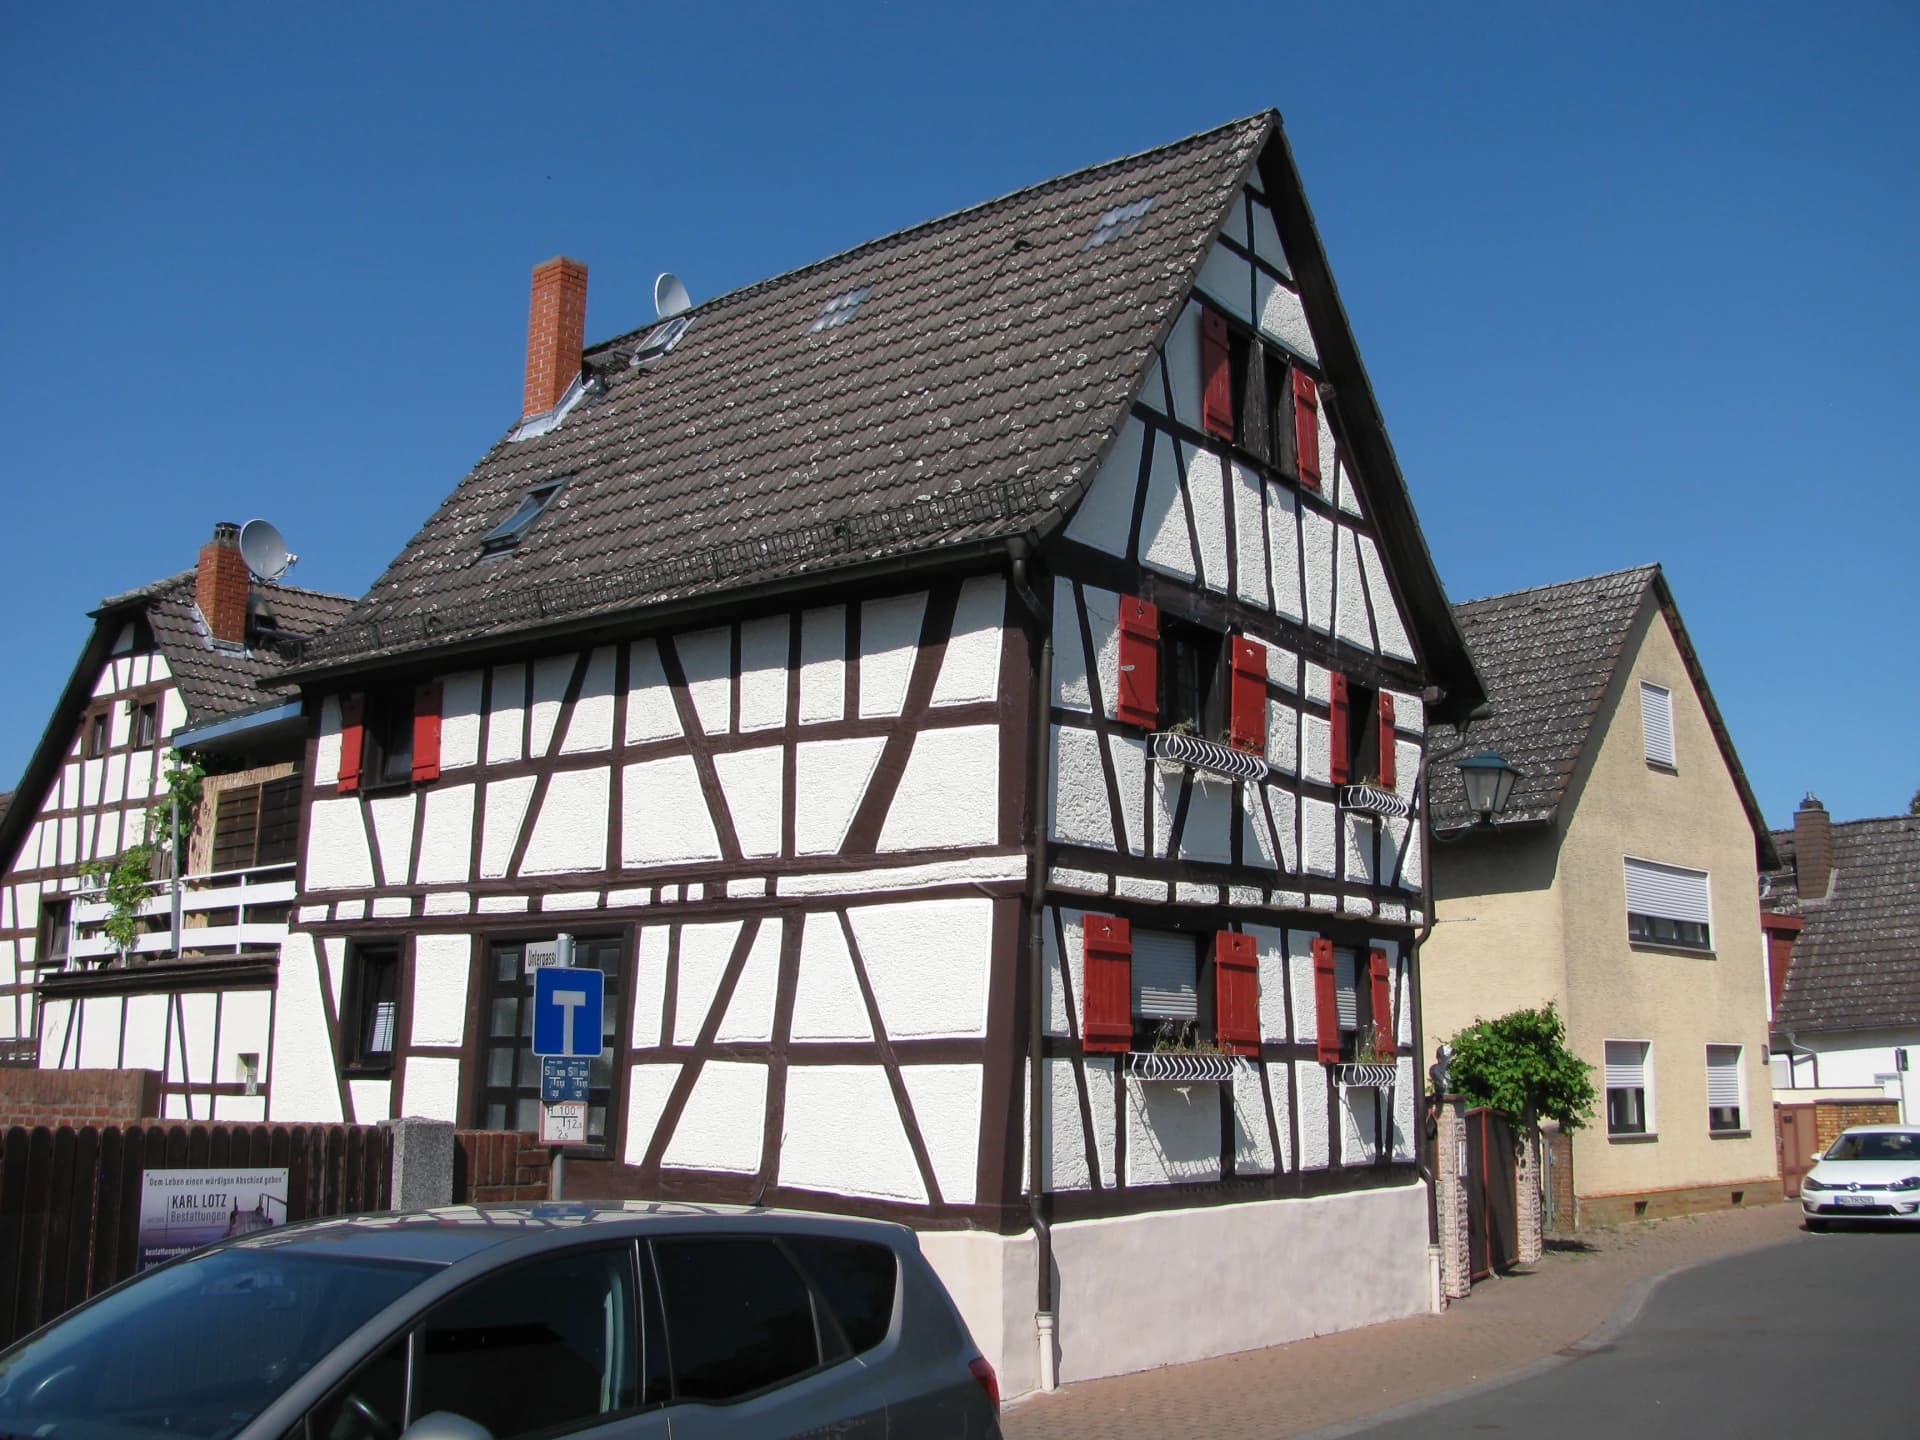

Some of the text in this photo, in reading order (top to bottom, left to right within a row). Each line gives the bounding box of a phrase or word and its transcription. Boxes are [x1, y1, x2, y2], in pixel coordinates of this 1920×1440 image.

[560, 1106, 576, 1115] 100
[149, 1178, 163, 1186] Dem
[165, 1177, 184, 1186] Leben
[236, 1176, 263, 1184] Abschied
[172, 1194, 227, 1209] KARL LOTZ
[171, 1211, 226, 1224] Bestattungen
